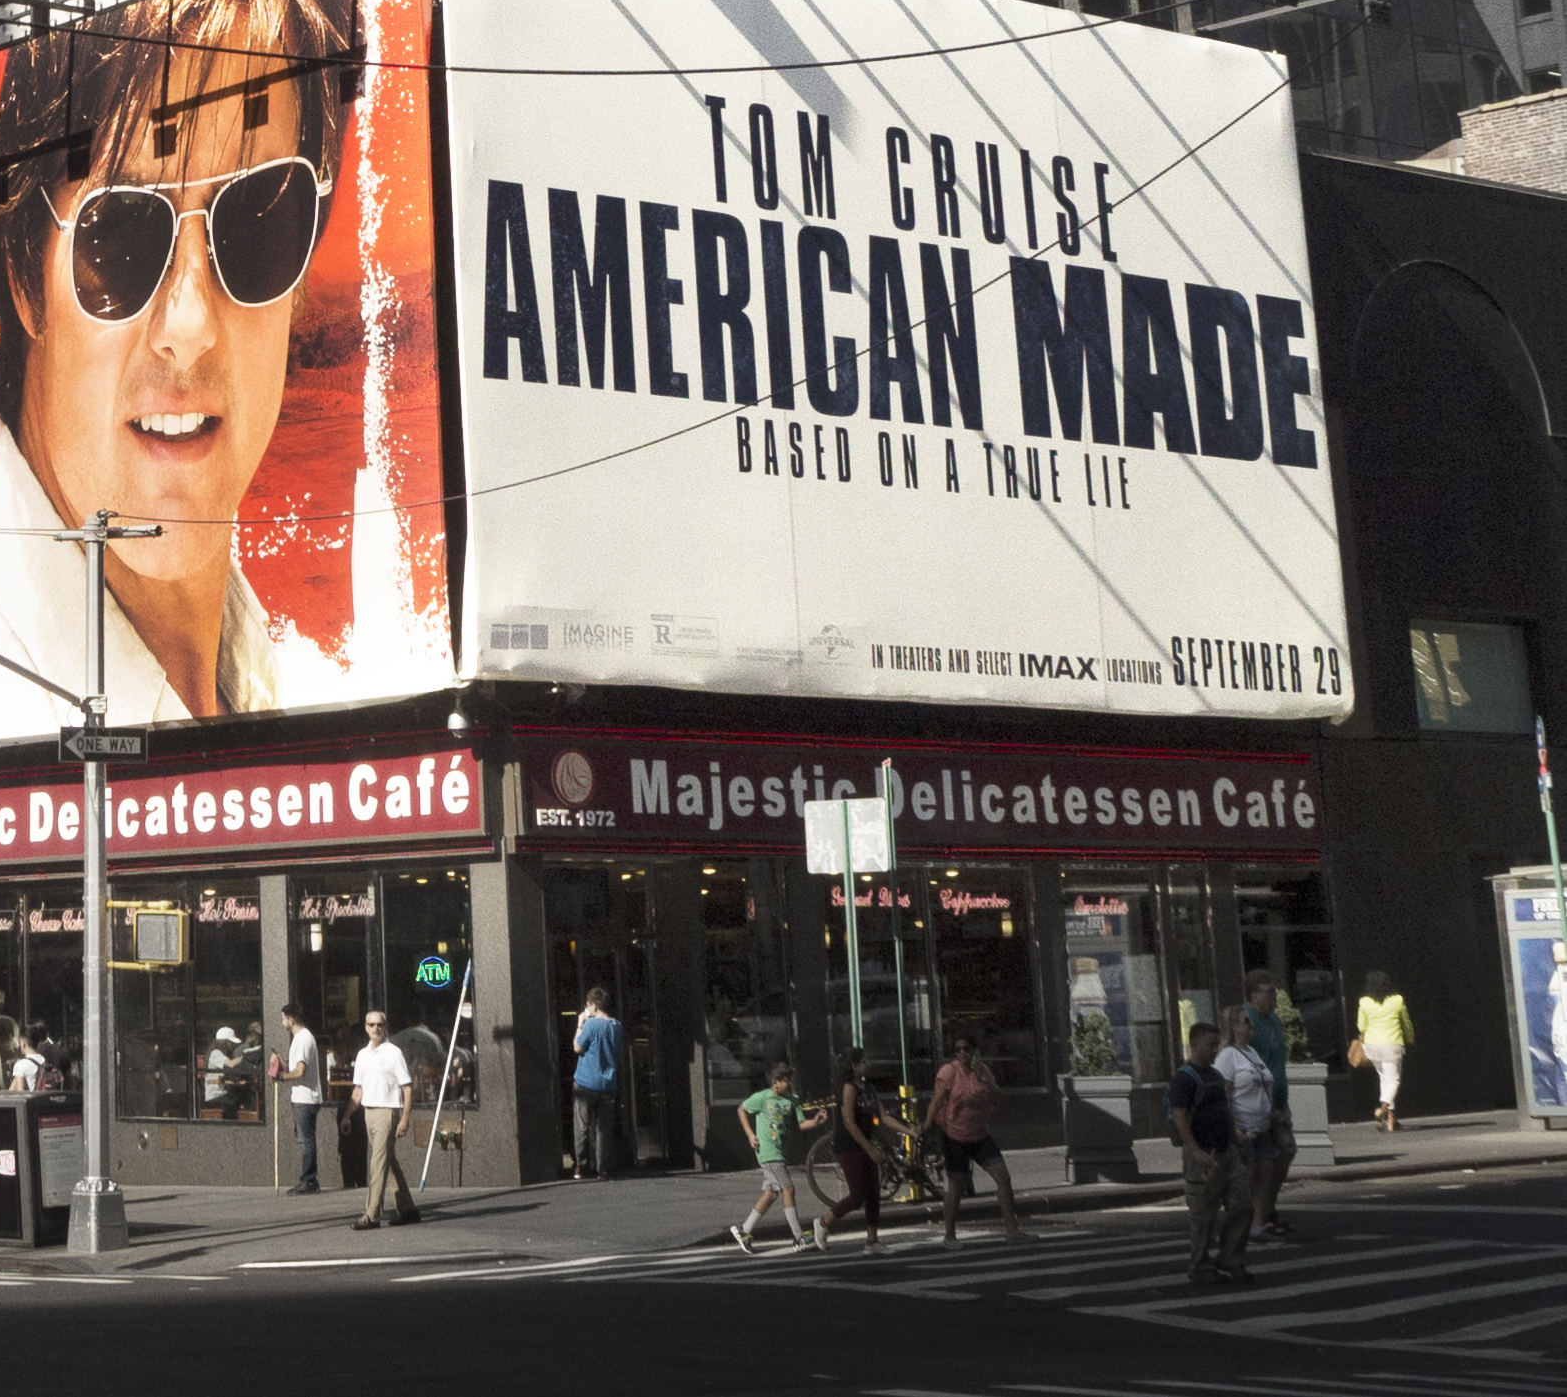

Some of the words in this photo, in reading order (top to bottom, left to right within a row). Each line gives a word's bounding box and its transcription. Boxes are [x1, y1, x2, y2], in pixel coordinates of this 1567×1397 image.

[705, 95, 836, 220] TOM
[886, 126, 1118, 263] CRUISE
[483, 179, 984, 432] AMERICAN
[1009, 255, 1318, 469] MADE
[737, 416, 851, 484] BASED
[879, 431, 918, 490] ON
[946, 438, 961, 494] A
[983, 441, 1061, 504] TRUE
[1085, 453, 1131, 510] LIE
[871, 643, 883, 669] IN
[889, 645, 942, 672] THEATERS
[948, 648, 970, 673] AND
[976, 650, 1012, 677] SELECT
[1019, 653, 1098, 681] IMAX
[1106, 658, 1162, 685] LOCATIONS
[1171, 636, 1302, 693] SEPTEMBER
[1313, 646, 1342, 696] 29
[76, 737, 103, 752] ONE
[109, 738, 136, 753] WAY
[30, 782, 334, 843] Deicatessen
[348, 755, 470, 821] Café
[536, 807, 573, 827] EST.
[575, 809, 616, 827] 1972
[875, 766, 1202, 829] Delicatessen
[1213, 778, 1316, 830] Café
[415, 963, 451, 981] ATM
